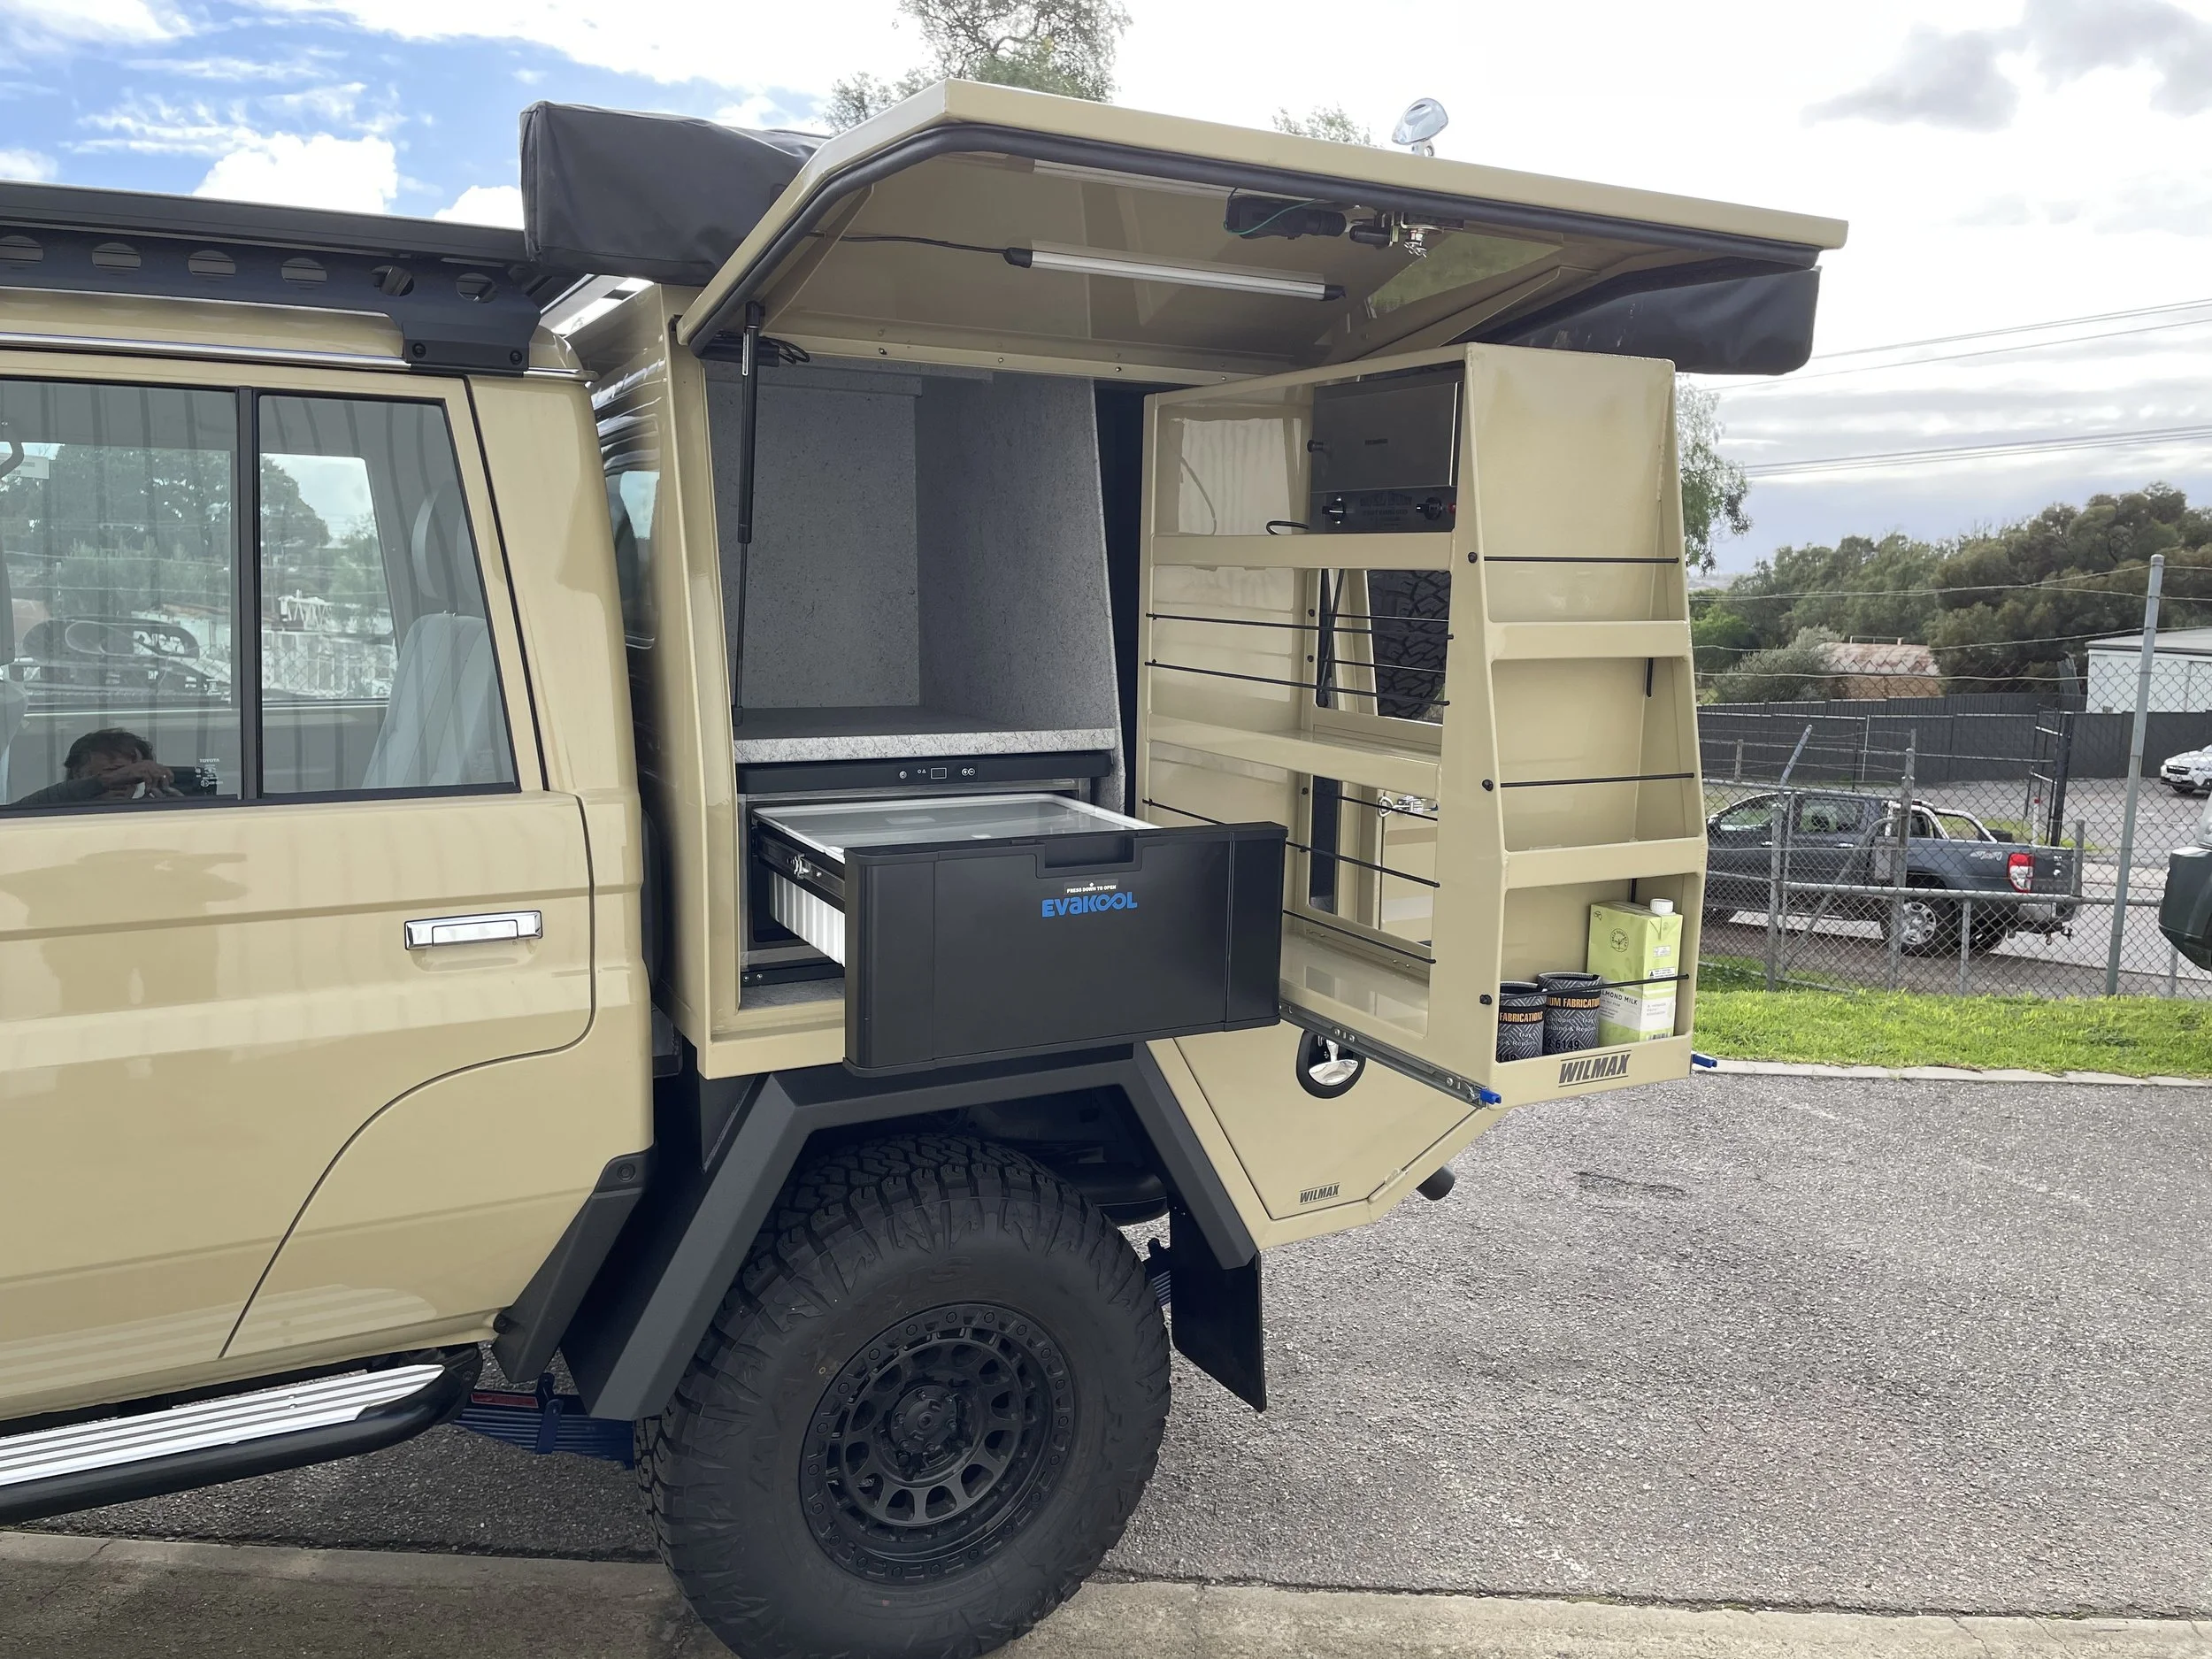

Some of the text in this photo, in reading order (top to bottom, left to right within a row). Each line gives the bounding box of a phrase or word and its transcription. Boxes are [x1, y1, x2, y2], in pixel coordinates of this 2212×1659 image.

[1600, 989, 1623, 1001] LMOND
[1624, 996, 1638, 1006] MILK
[1499, 1011, 1543, 1023] FABRICATIONS
[1555, 1039, 1579, 1050] 6149
[1559, 1054, 1632, 1084] WILMAX
[1300, 1184, 1340, 1203] WILMAX
